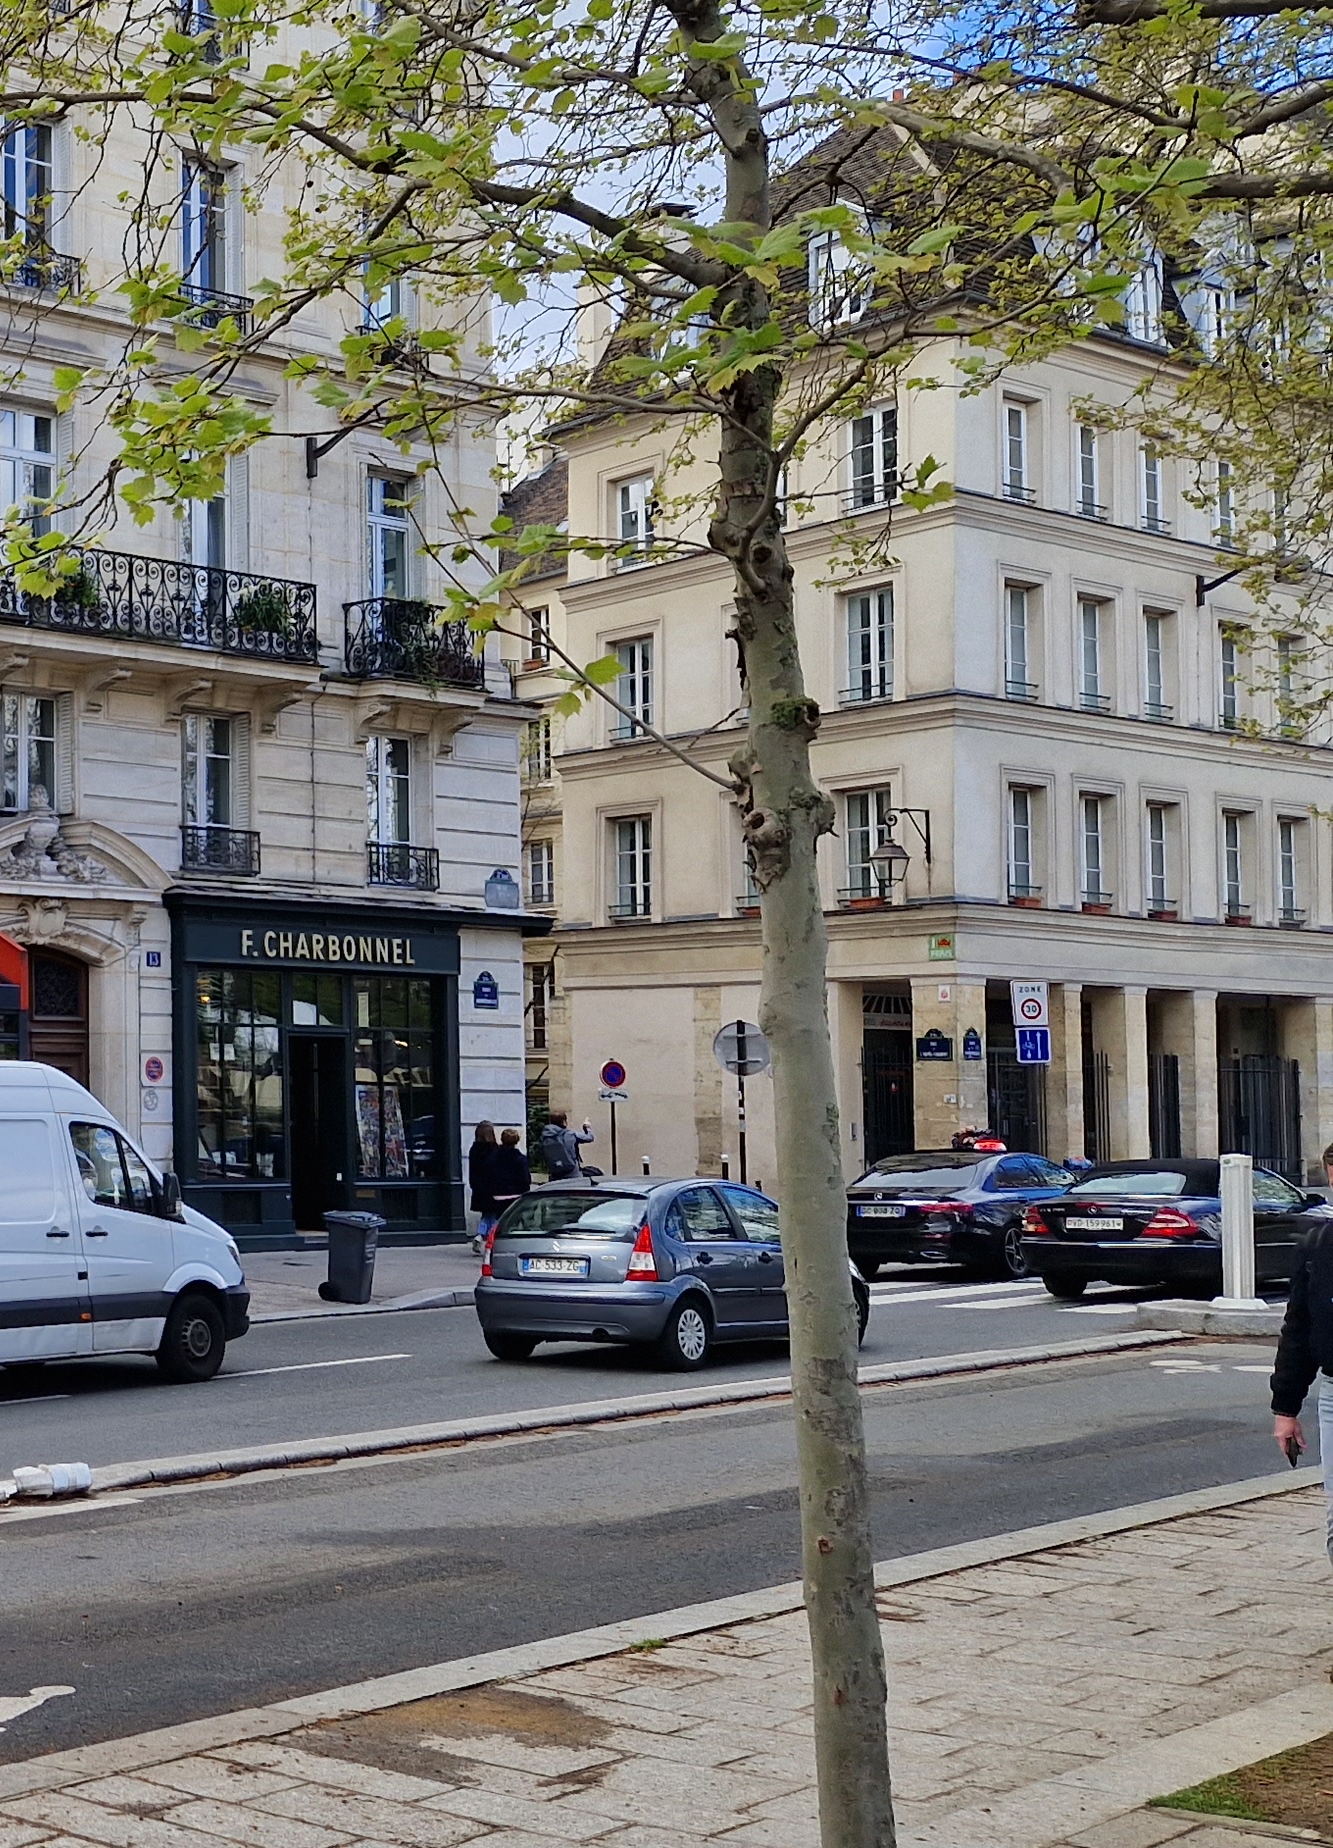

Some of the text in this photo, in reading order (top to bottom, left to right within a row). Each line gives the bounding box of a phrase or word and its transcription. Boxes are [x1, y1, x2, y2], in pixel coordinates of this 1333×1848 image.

[241, 929, 416, 964] F. CHARBONNEL
[148, 952, 160, 966] 13
[1026, 1004, 1037, 1012] 30
